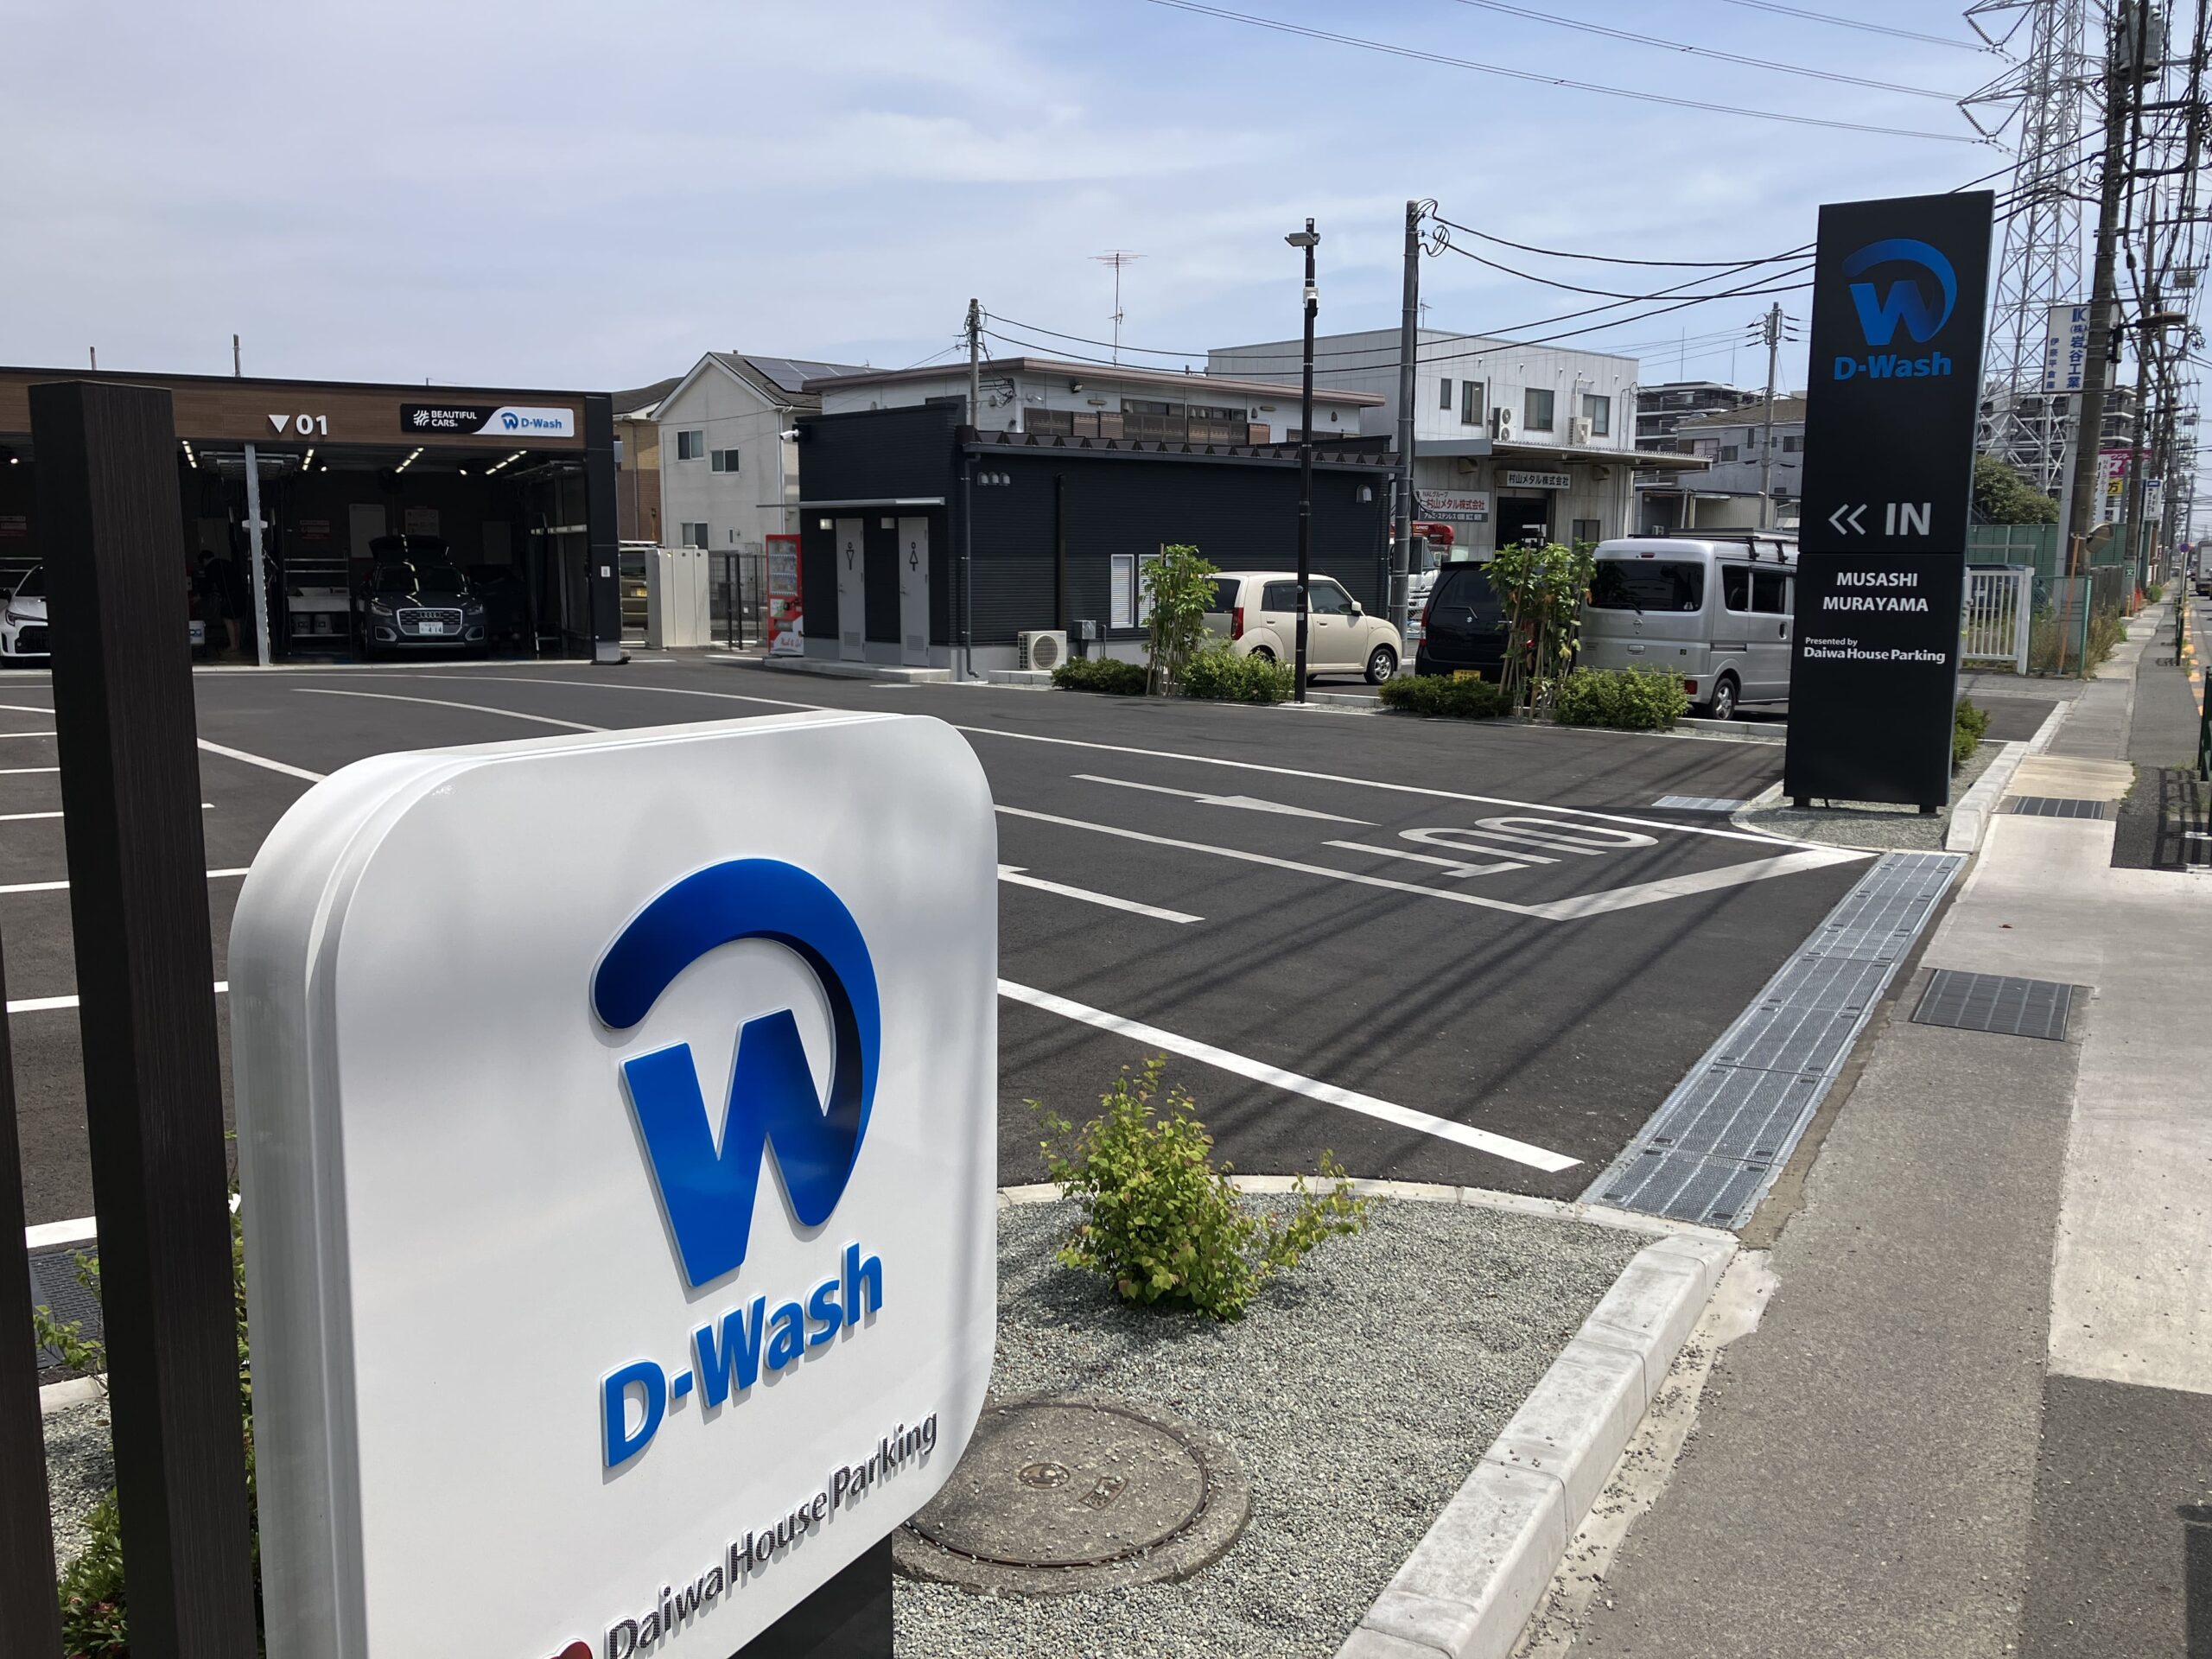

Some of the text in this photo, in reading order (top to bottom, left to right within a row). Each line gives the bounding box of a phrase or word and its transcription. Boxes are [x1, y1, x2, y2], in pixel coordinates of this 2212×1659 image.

[1834, 351, 1951, 380] D-Wash
[431, 410, 478, 420] BEAUTIFUL
[521, 418, 563, 429] D-Wash
[296, 414, 328, 435] 01
[1509, 474, 1569, 486] 村山メタル株式会社
[1885, 502, 1932, 536] IN
[1836, 572, 1918, 587] MUSASHI
[1822, 596, 1929, 612] MURAYAMA
[1805, 637, 1859, 647] Presented by
[1803, 646, 1946, 664] Daiwa House Parking
[600, 1240, 884, 1469] D-Wash
[603, 1410, 938, 1658] Daiwa House Parking
